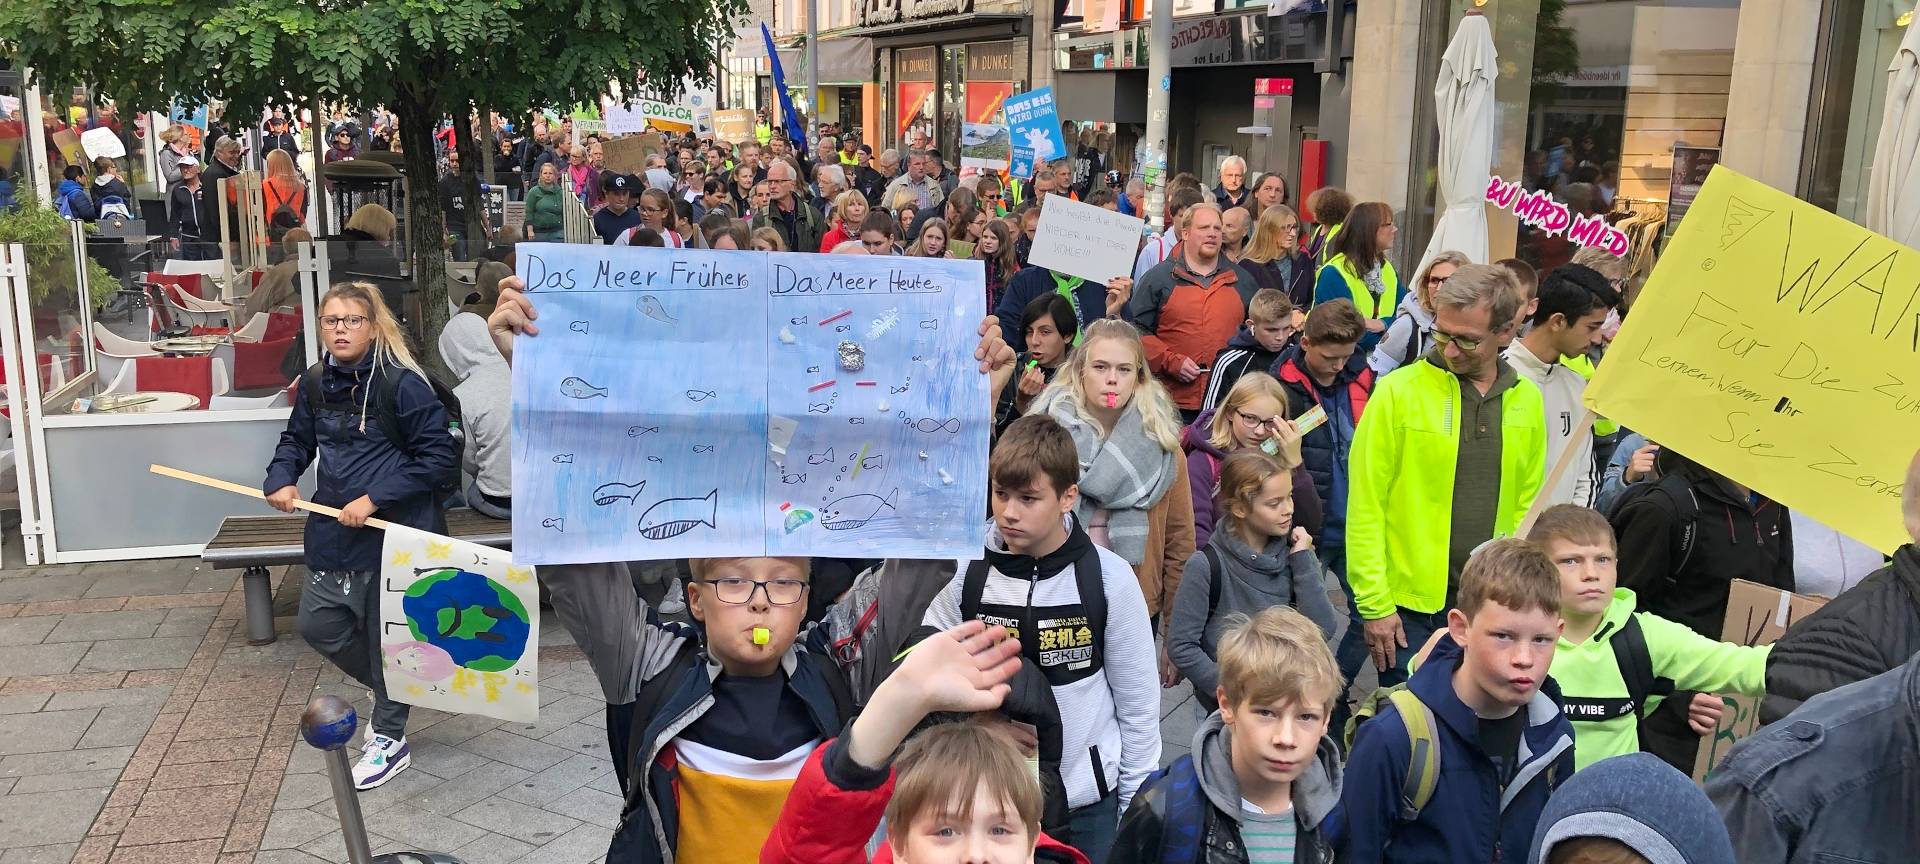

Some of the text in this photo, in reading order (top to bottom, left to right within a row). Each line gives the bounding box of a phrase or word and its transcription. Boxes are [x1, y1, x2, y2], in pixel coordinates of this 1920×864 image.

[1032, 92, 1052, 107] EIS
[1008, 110, 1033, 126] WIRD
[1514, 192, 1570, 230] WIRD
[1570, 215, 1628, 256] WILD
[525, 255, 576, 291] Das
[592, 260, 657, 289] Meer
[774, 263, 823, 294] Das
[826, 271, 879, 291] Meer
[1777, 210, 1920, 352] WA
[1773, 341, 1861, 393] Die
[1708, 411, 1797, 459] Sie
[1039, 626, 1093, 650] 没机会
[1579, 704, 1605, 715] VIBE
